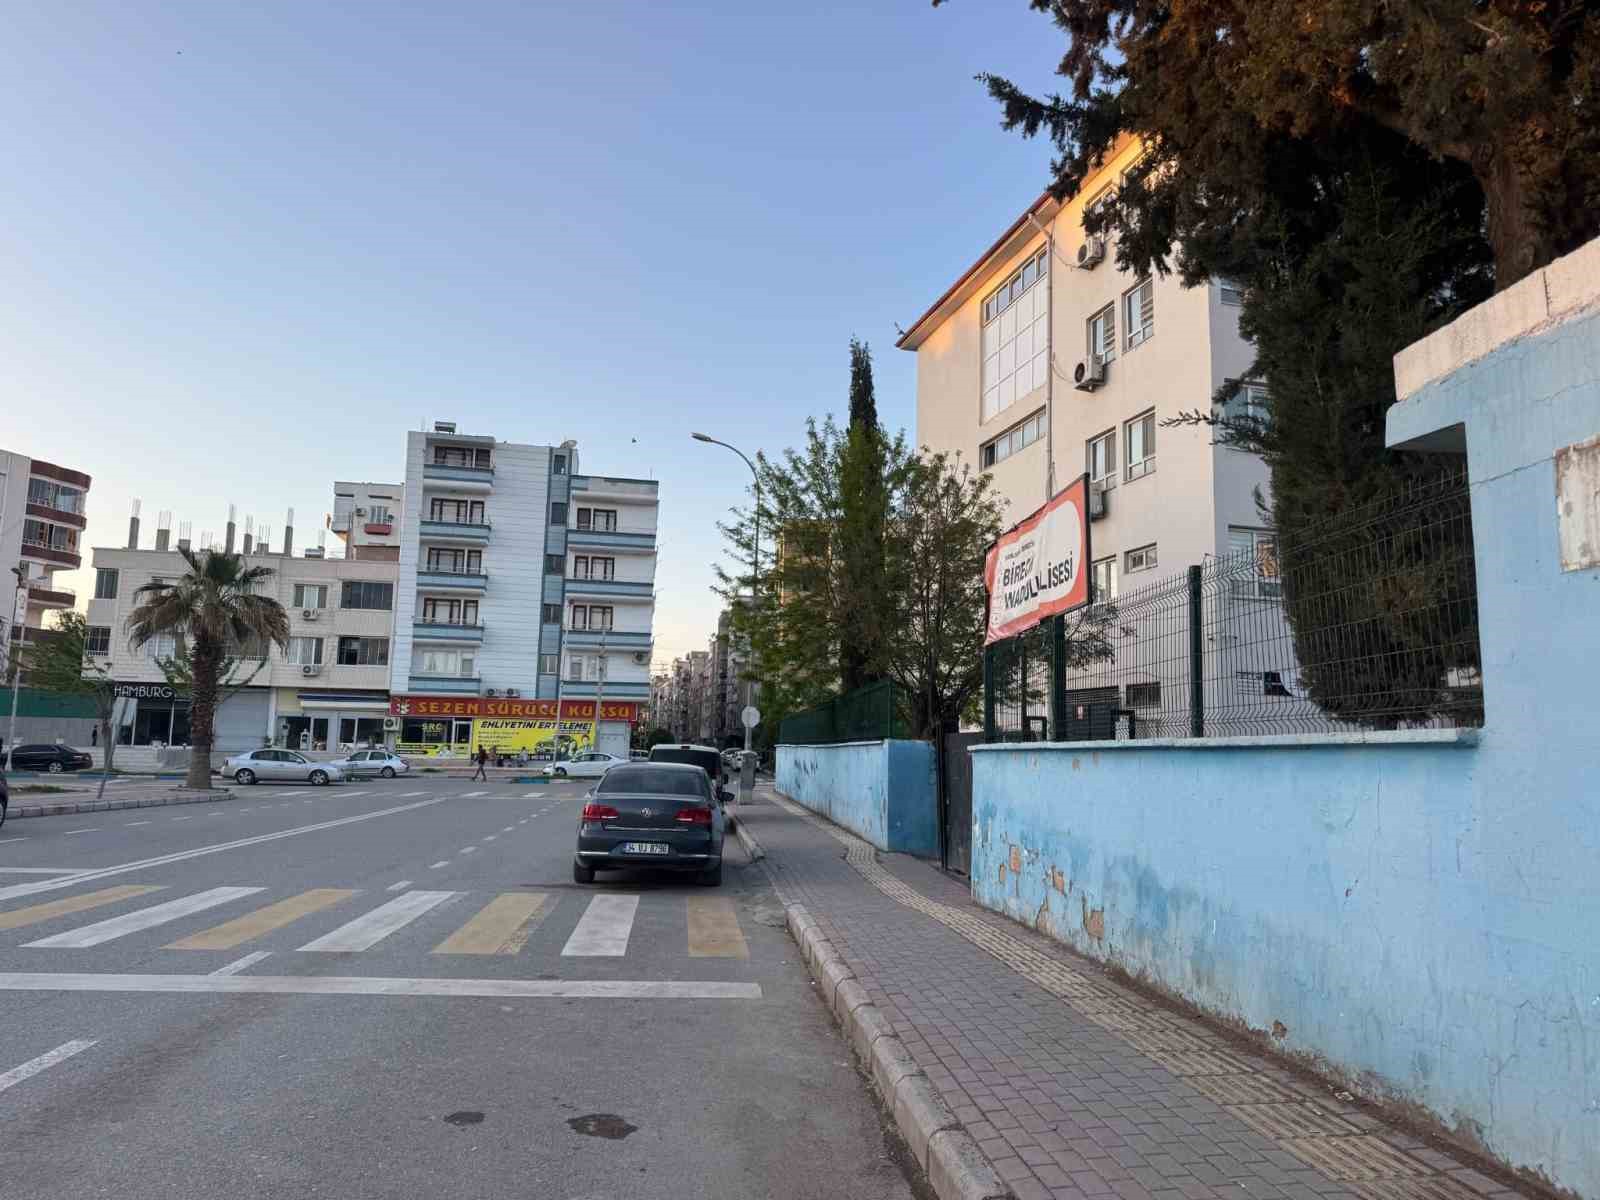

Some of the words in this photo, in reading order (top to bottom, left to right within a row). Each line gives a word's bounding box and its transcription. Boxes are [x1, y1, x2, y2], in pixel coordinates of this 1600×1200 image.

[1039, 550, 1073, 590] LİSESİ
[114, 685, 174, 698] HAMBURG
[417, 702, 479, 713] SEZEN
[569, 704, 630, 717] KURSU
